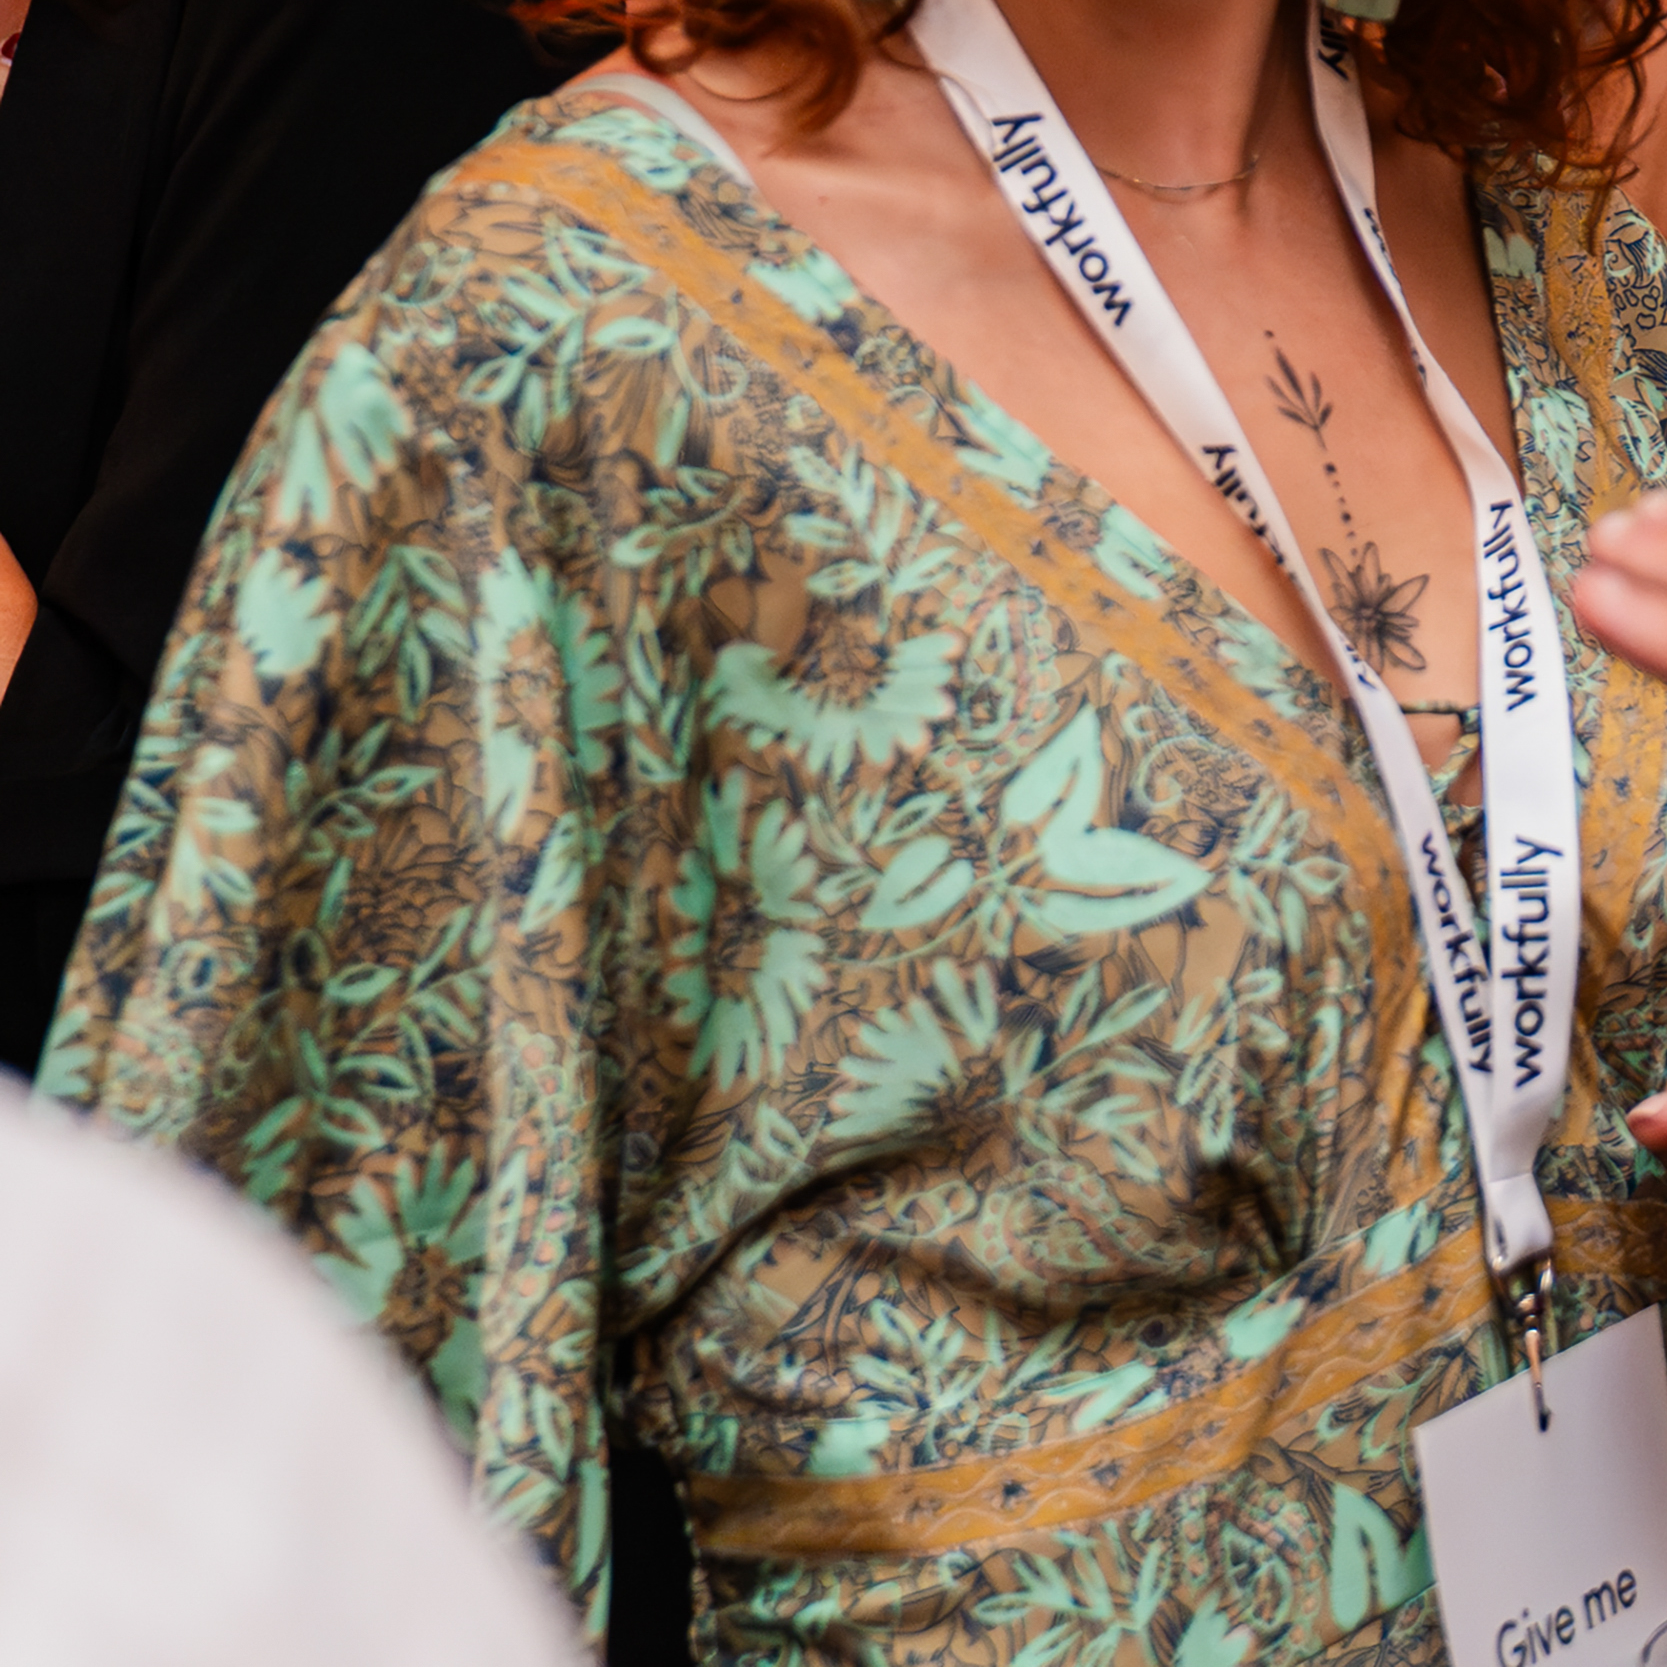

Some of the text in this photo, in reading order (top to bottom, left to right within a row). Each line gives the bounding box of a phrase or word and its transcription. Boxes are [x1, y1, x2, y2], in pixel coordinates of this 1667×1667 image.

[991, 112, 1132, 328] workfully
[1483, 499, 1537, 712] workfully
[1421, 831, 1493, 1073] workfully
[1500, 835, 1564, 1088] workfully
[1497, 1569, 1637, 1667] Give me
